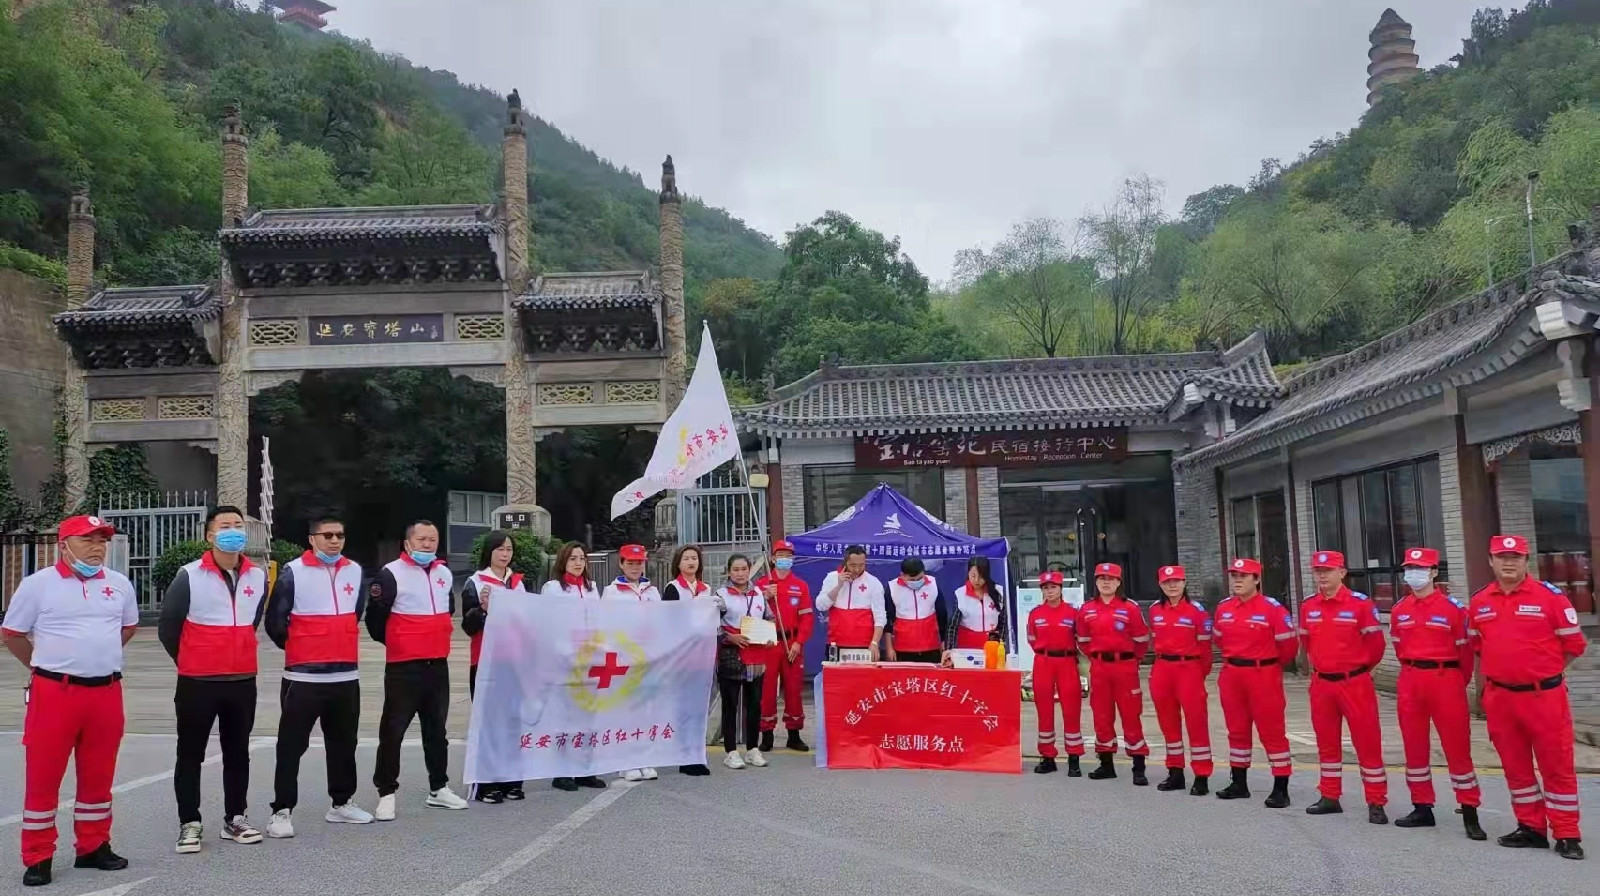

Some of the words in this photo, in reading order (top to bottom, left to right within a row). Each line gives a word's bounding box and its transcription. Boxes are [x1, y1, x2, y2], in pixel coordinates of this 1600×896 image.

[1080, 451, 1104, 460] Center
[505, 513, 525, 522] 出口
[844, 676, 999, 732] 延安市宝塔区红十字会
[879, 733, 965, 753] 志愿服务点
